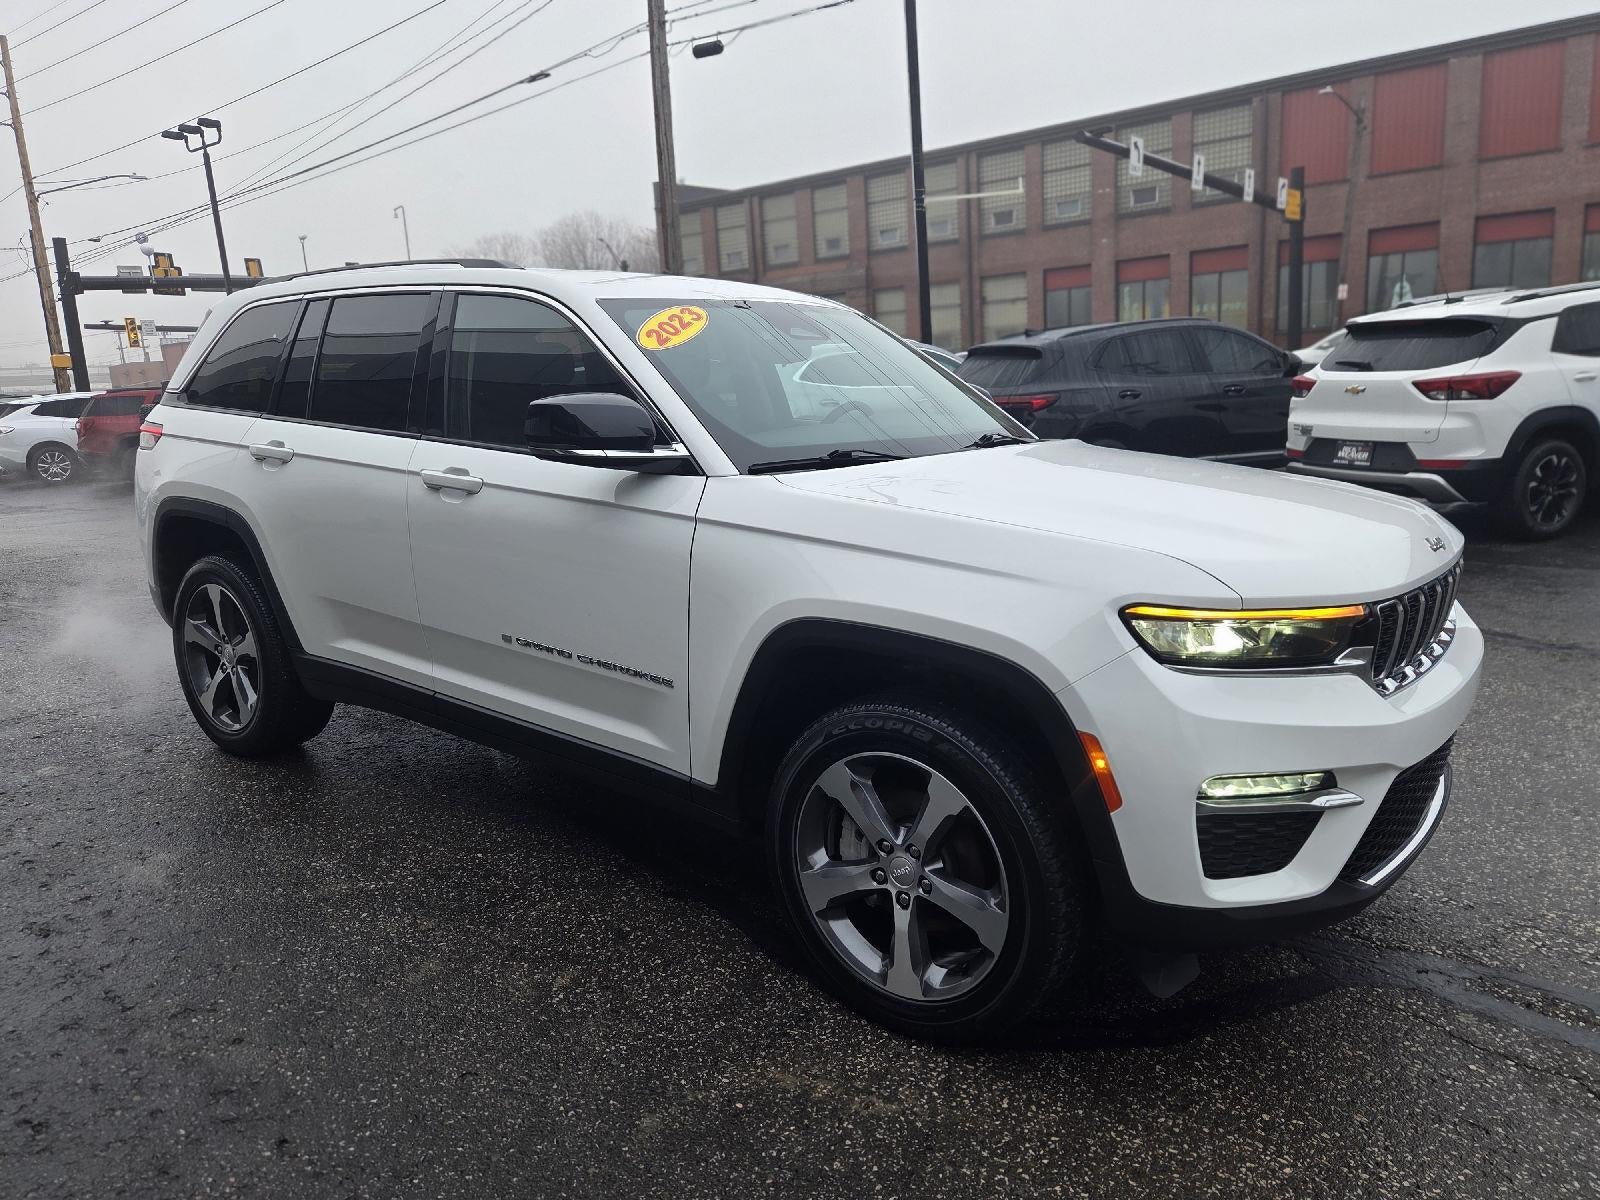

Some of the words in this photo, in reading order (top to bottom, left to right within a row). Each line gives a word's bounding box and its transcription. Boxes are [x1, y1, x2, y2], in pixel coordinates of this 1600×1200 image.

[645, 307, 703, 347] 2023
[1424, 536, 1447, 552] Jeep
[515, 637, 573, 659] GRAND
[576, 653, 675, 688] CHEROKEE
[892, 865, 911, 877] Jeep
